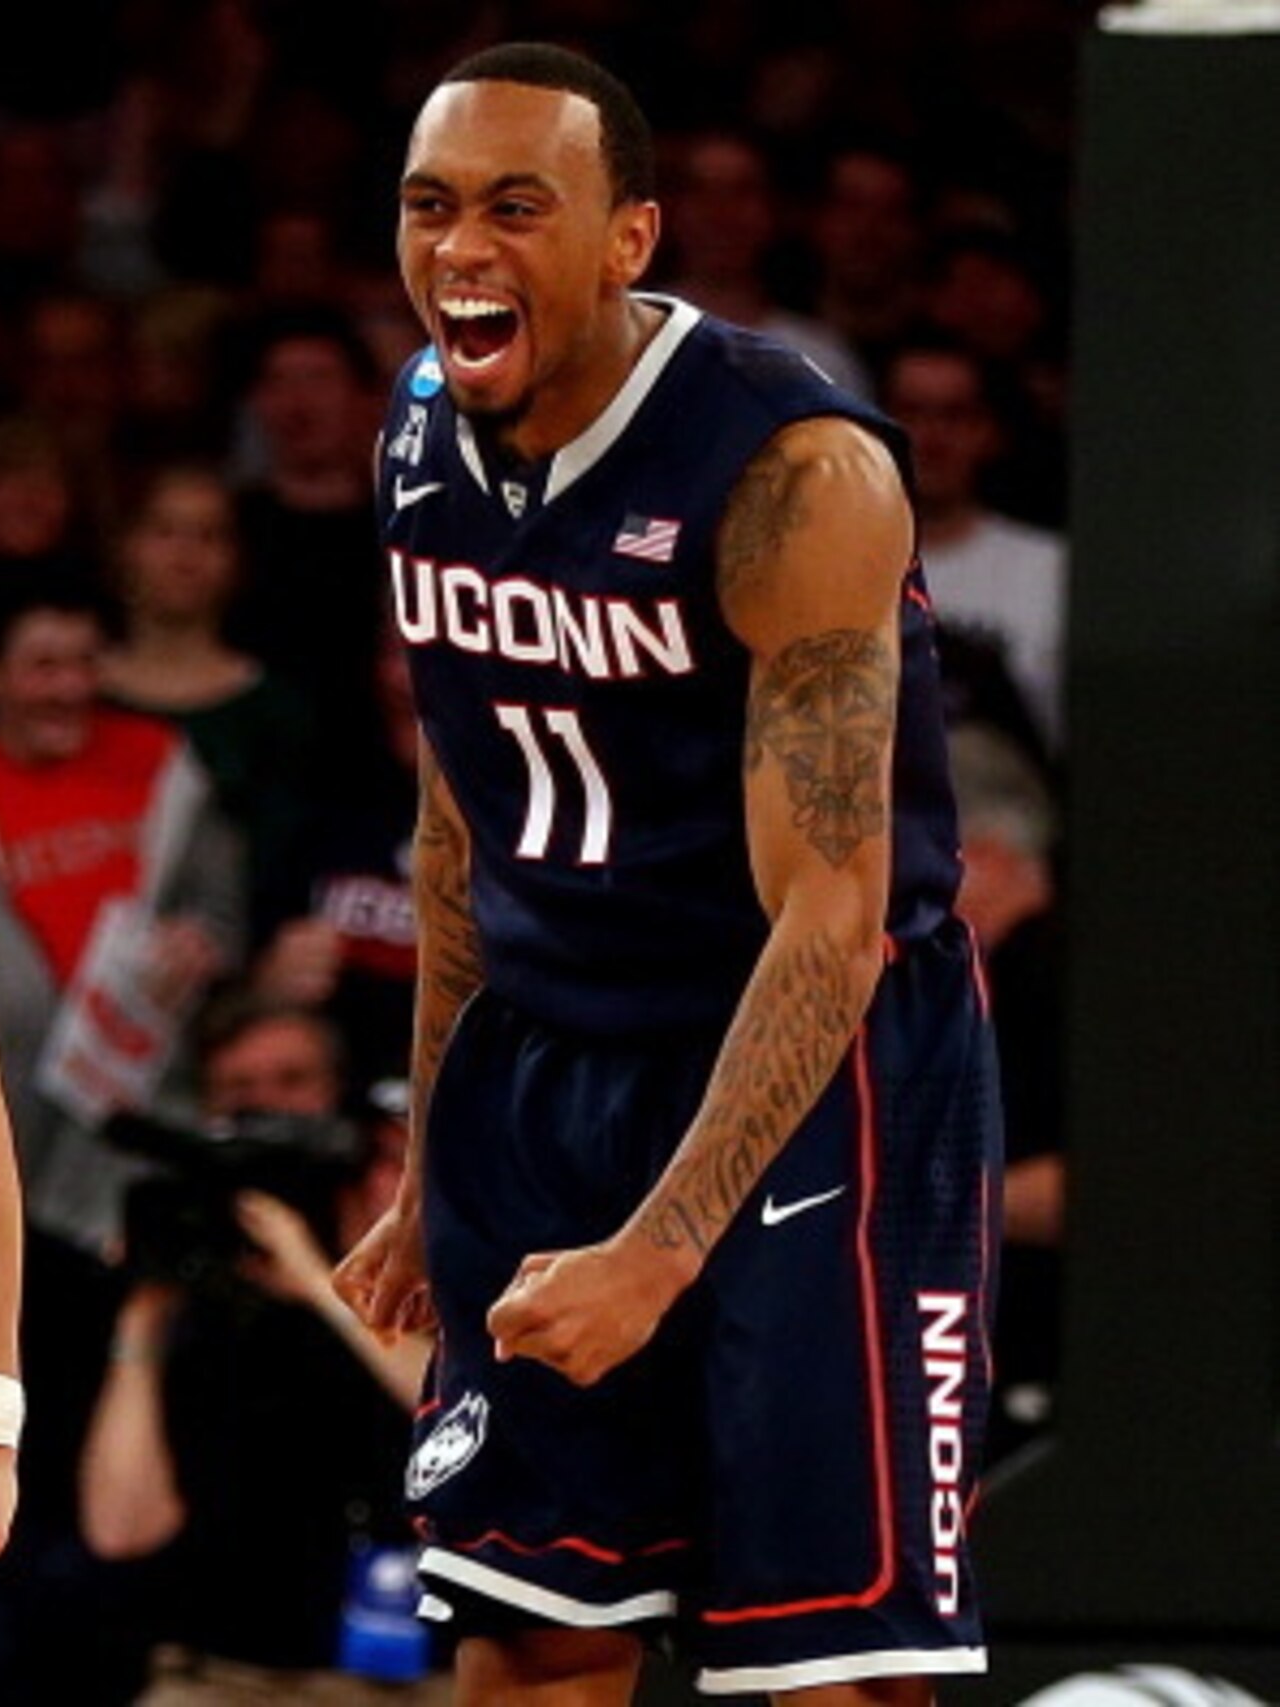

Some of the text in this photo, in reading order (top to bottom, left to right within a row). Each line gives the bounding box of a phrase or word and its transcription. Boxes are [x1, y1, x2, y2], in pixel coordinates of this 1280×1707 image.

[388, 547, 695, 681] UCONN
[494, 702, 613, 864] 11
[916, 1292, 967, 1615] UCONN
